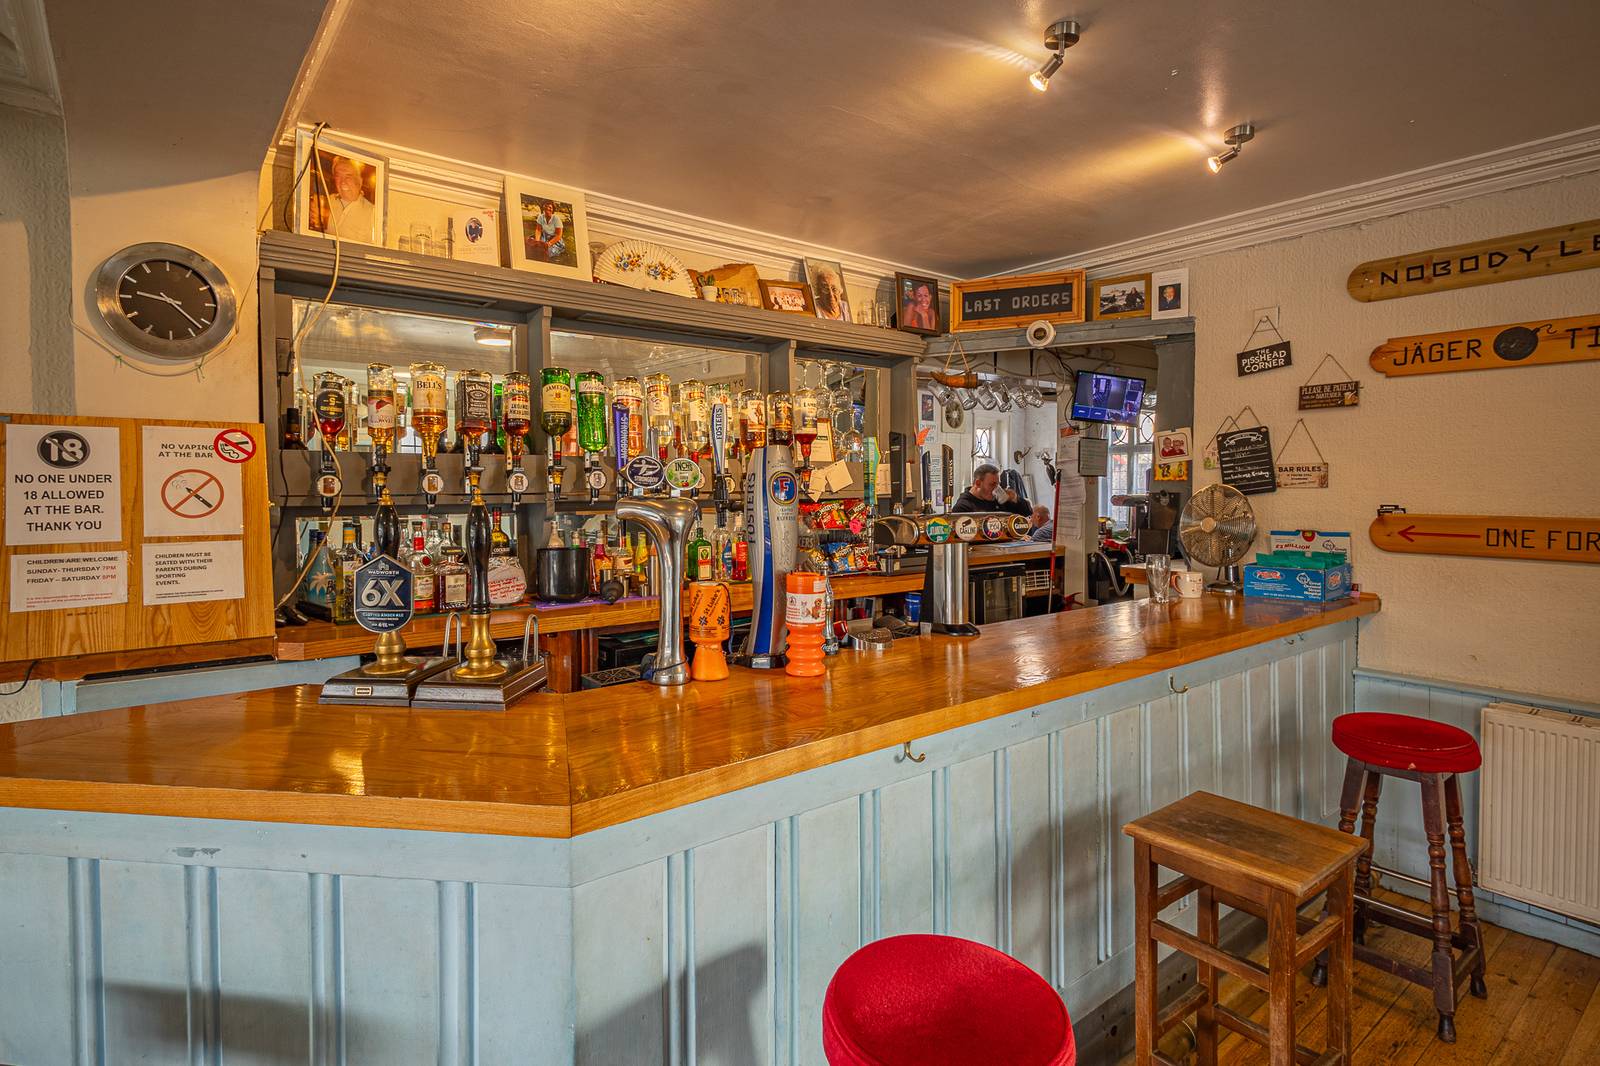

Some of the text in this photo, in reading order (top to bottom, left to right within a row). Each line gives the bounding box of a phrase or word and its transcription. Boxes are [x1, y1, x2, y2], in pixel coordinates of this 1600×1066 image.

[1380, 245, 1539, 286] NOBODY
[964, 292, 1071, 313] LAST ORDERS
[1241, 350, 1287, 367] PISSHEAD
[1255, 348, 1270, 356] THE
[1393, 338, 1482, 366] JÄGER
[1244, 359, 1285, 373] CORNER
[416, 381, 442, 390] BELL'S
[545, 385, 569, 393] JAMESON
[1302, 383, 1356, 395] PLEASE BE PATIENT
[45, 437, 84, 462] 18
[14, 473, 113, 484] NO ONE UNDER
[23, 489, 104, 500] 18 ALLOWED
[24, 504, 104, 515] AT THE BAR.
[26, 521, 102, 532] THANK YOU
[1485, 528, 1600, 551] ONE FOR
[361, 577, 405, 607] 6X
[707, 589, 721, 609] Luke's
